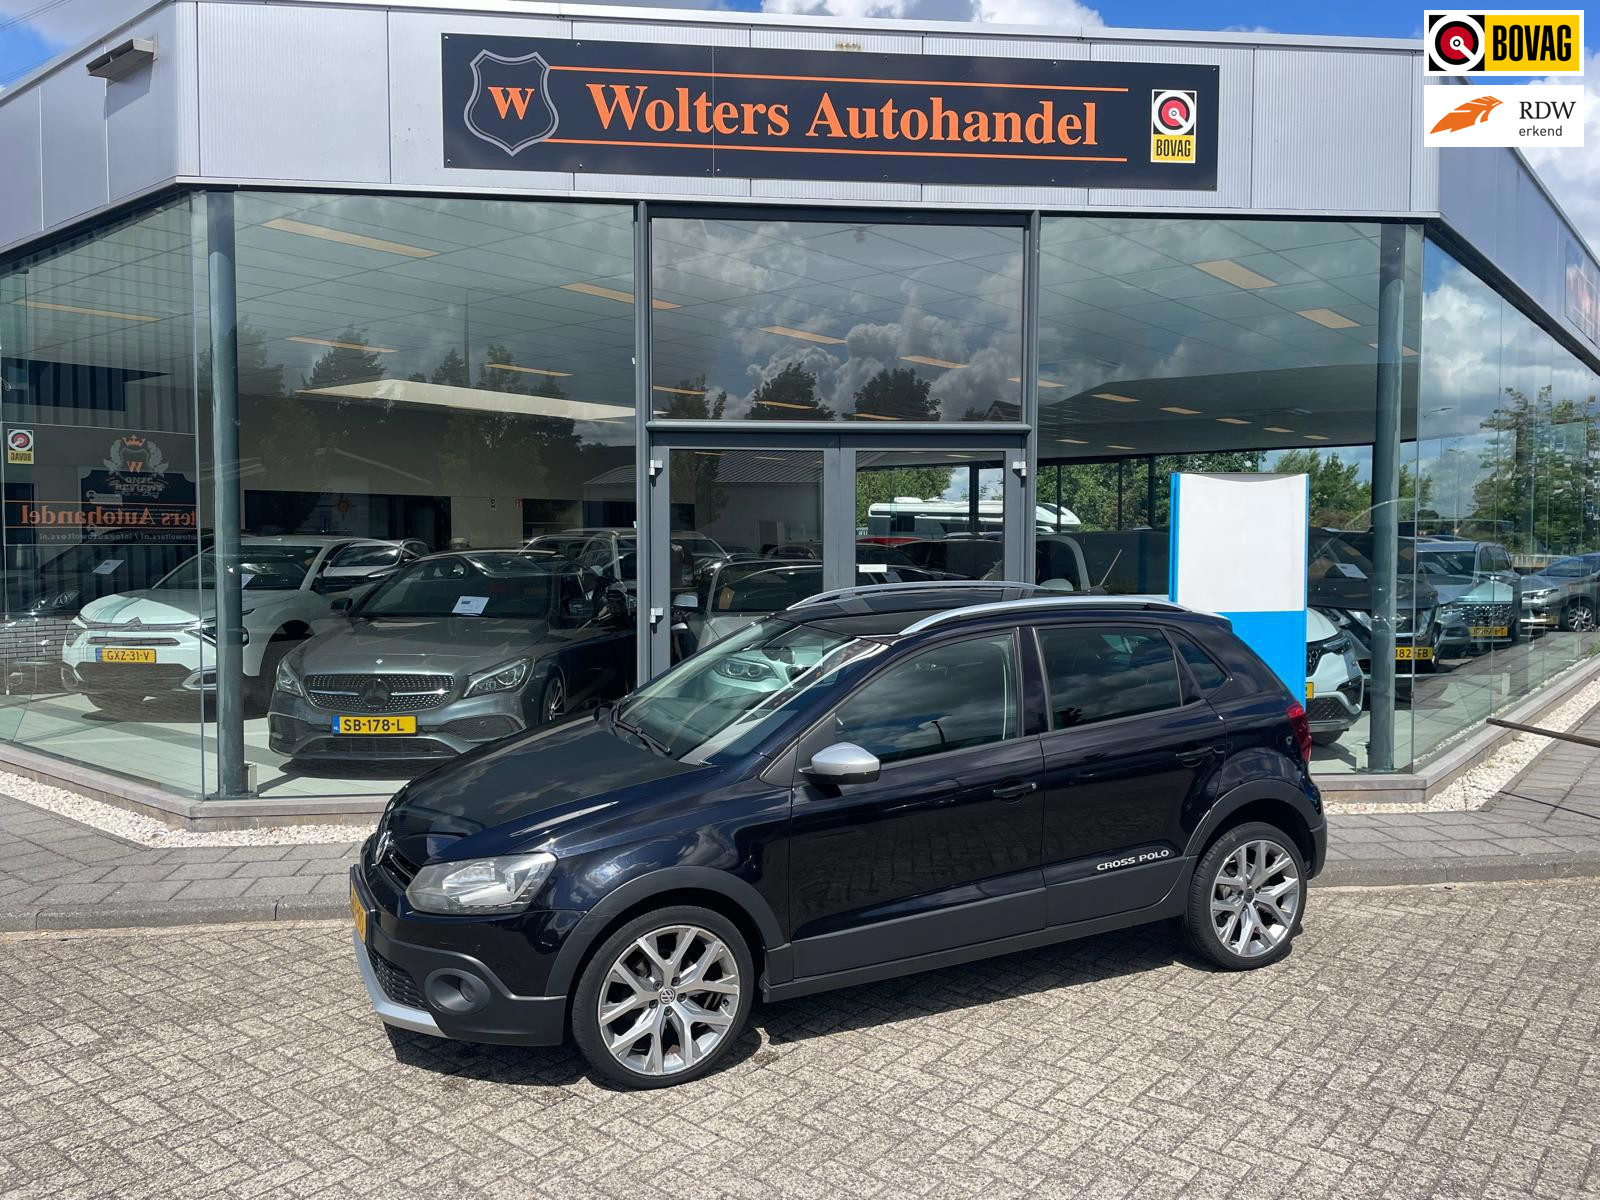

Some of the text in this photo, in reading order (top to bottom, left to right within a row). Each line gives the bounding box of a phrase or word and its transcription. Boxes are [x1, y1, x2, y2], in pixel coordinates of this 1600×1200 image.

[488, 86, 535, 121] W
[586, 83, 1098, 146] Wolters Autohandel
[1156, 138, 1191, 158] BOVAG
[107, 650, 150, 661] GXZ-31-V
[343, 718, 405, 732] SB-178-L
[1096, 849, 1170, 871] CROSS POLO
